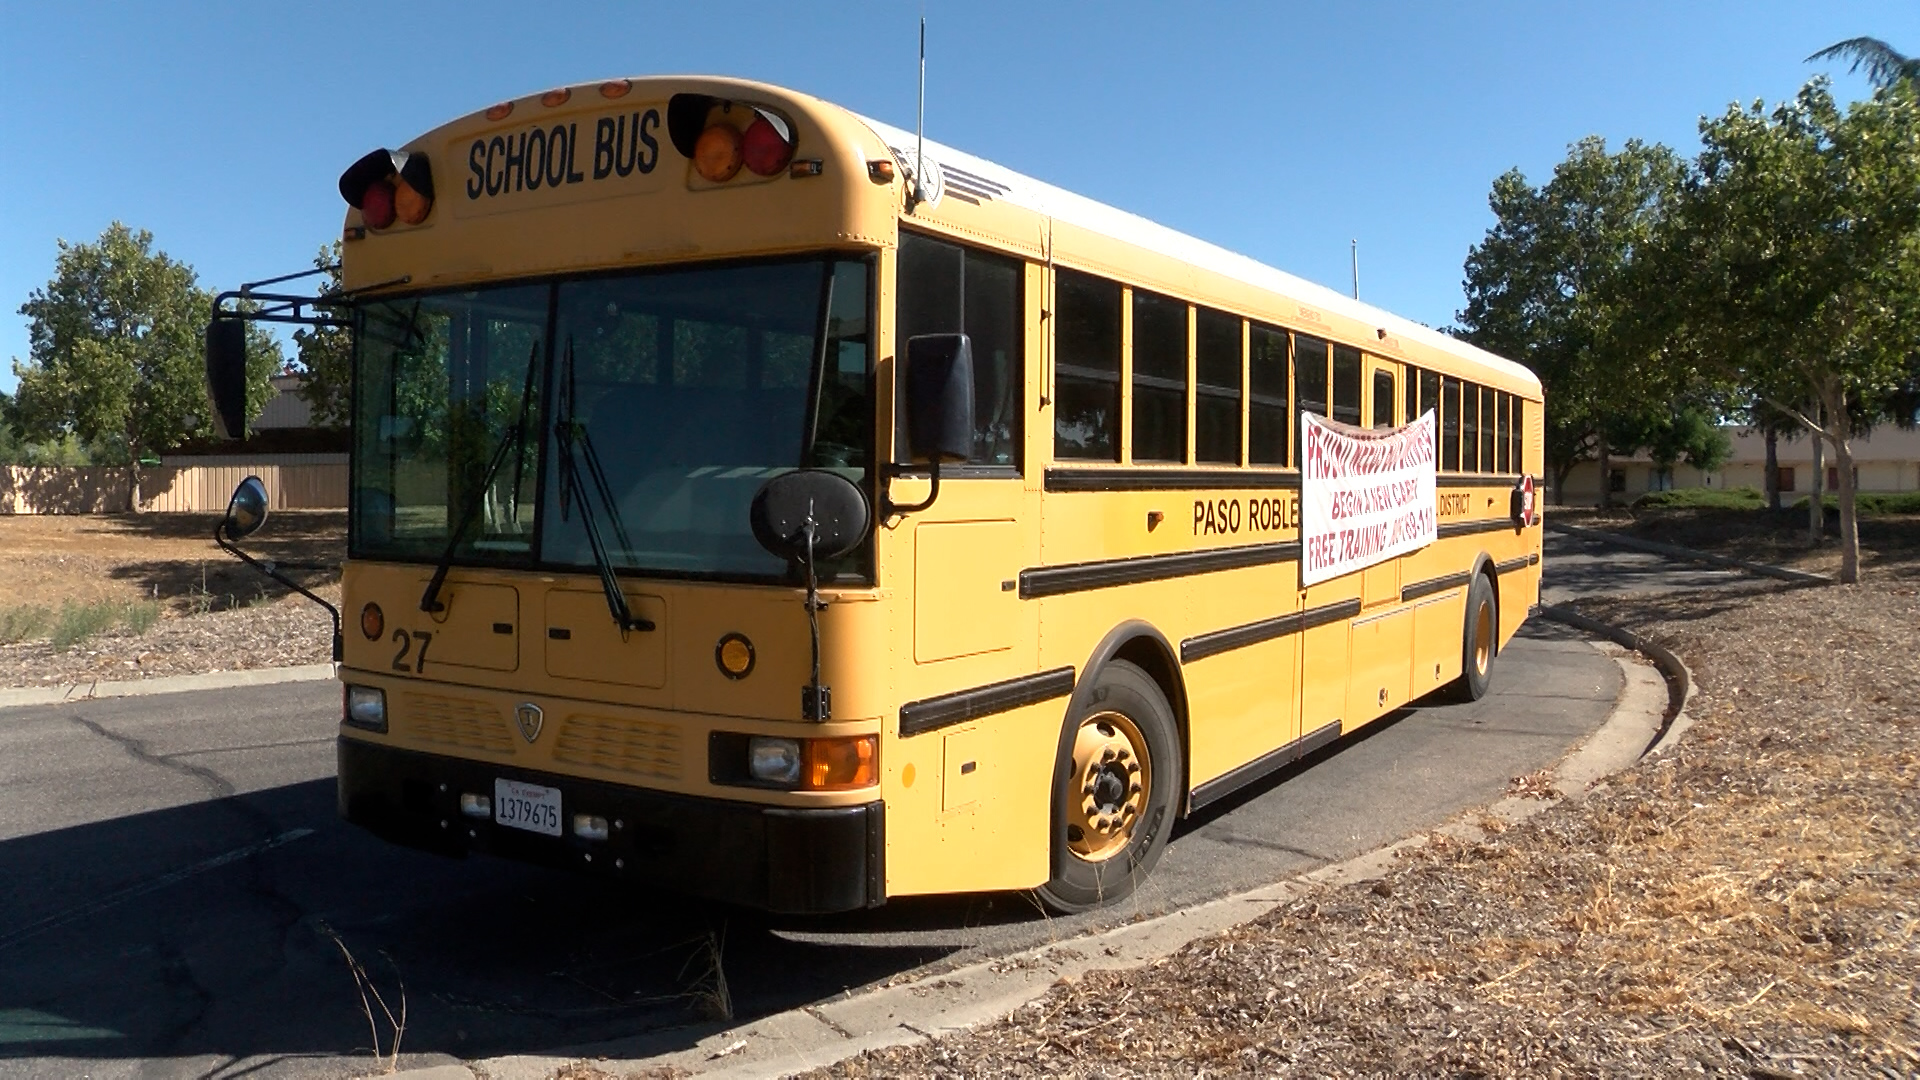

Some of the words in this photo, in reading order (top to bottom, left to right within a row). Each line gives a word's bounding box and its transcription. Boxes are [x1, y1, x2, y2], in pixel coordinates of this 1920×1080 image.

[467, 123, 584, 200] SCHOOL
[593, 108, 661, 180] BUS
[1193, 499, 1240, 534] PASO
[1331, 489, 1363, 520] BEGIN
[1440, 493, 1471, 516] DISTRICT
[1308, 532, 1336, 572] FREE
[1339, 521, 1388, 563] TRAINING
[391, 627, 433, 675] 27
[500, 797, 558, 828] 1379675
